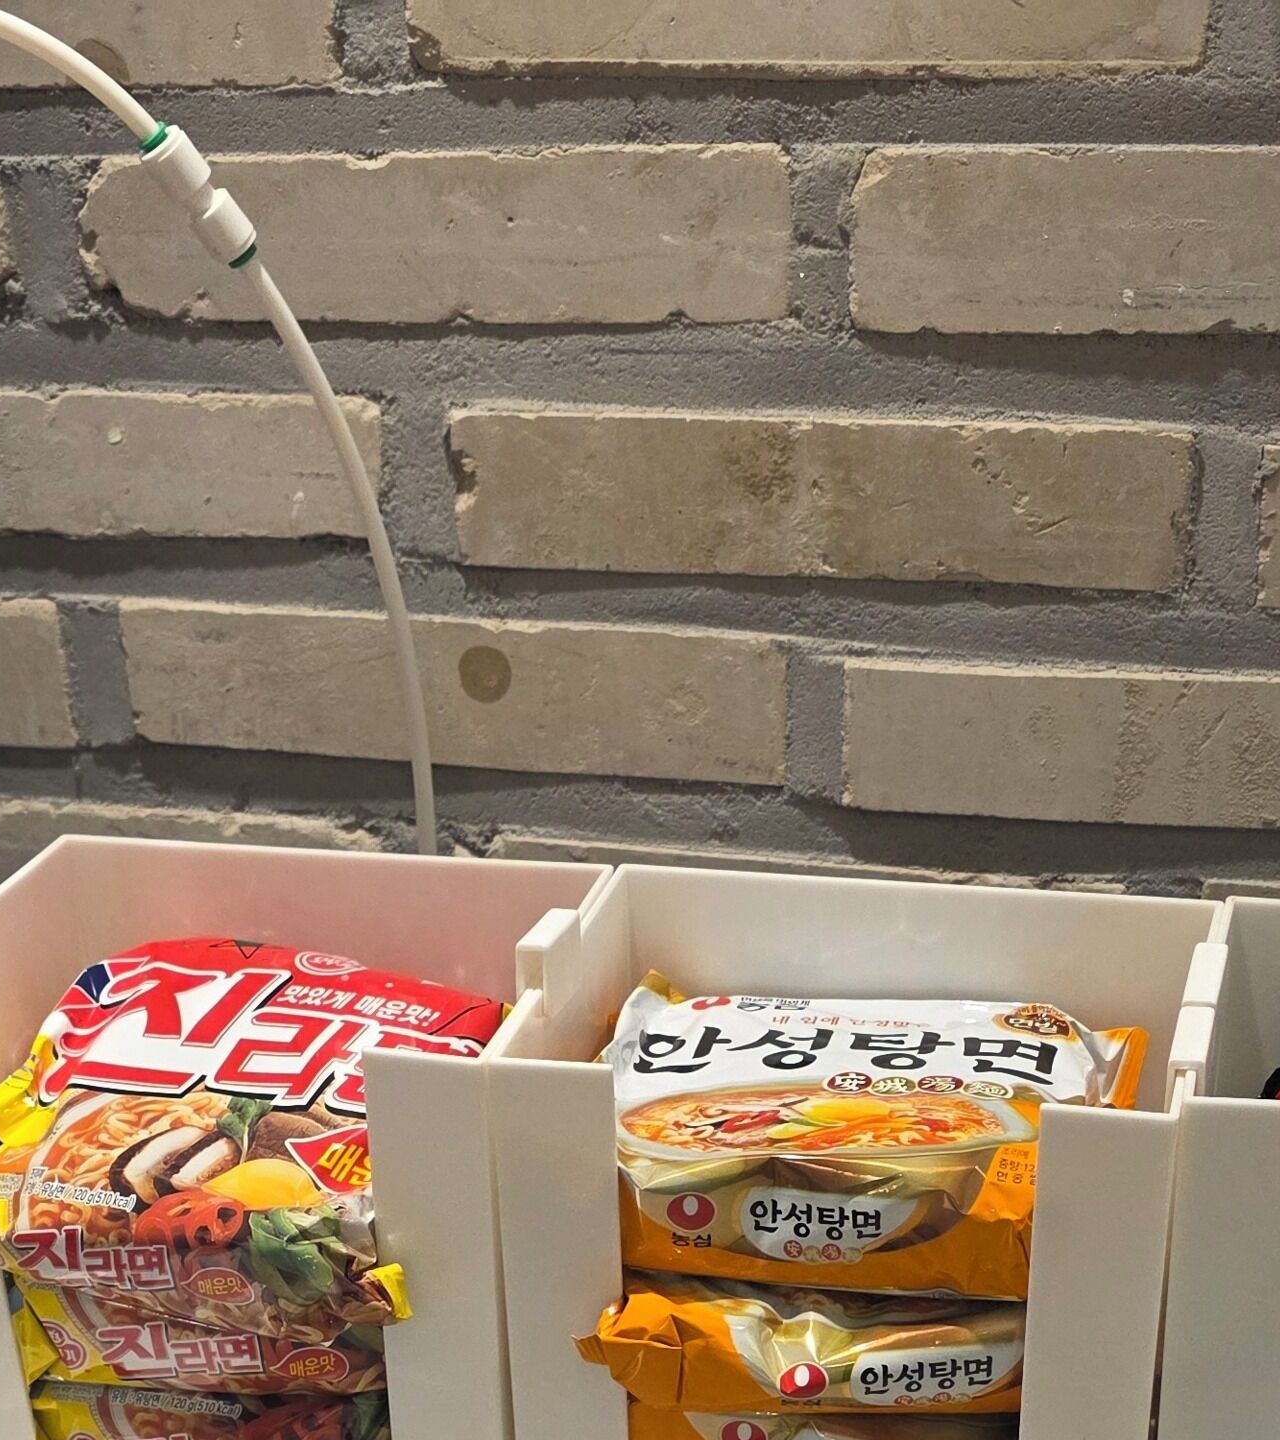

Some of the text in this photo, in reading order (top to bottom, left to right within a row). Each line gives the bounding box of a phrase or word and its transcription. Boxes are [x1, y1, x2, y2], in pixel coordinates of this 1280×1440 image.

[275, 983, 441, 1027] 맛있게 매운맛!
[632, 1025, 1059, 1086] 안성탕면
[72, 1188, 88, 1201] 120
[112, 1193, 136, 1211] kcal)
[749, 1198, 882, 1241] 안성탕면
[12, 1225, 175, 1289] 진라면
[671, 1231, 712, 1248] 농심
[197, 1277, 243, 1295] 매운맛
[96, 1321, 265, 1379] 진라면
[288, 1353, 336, 1378] 매운맛
[860, 1355, 993, 1396] 안성탕면
[170, 1395, 188, 1410] 120
